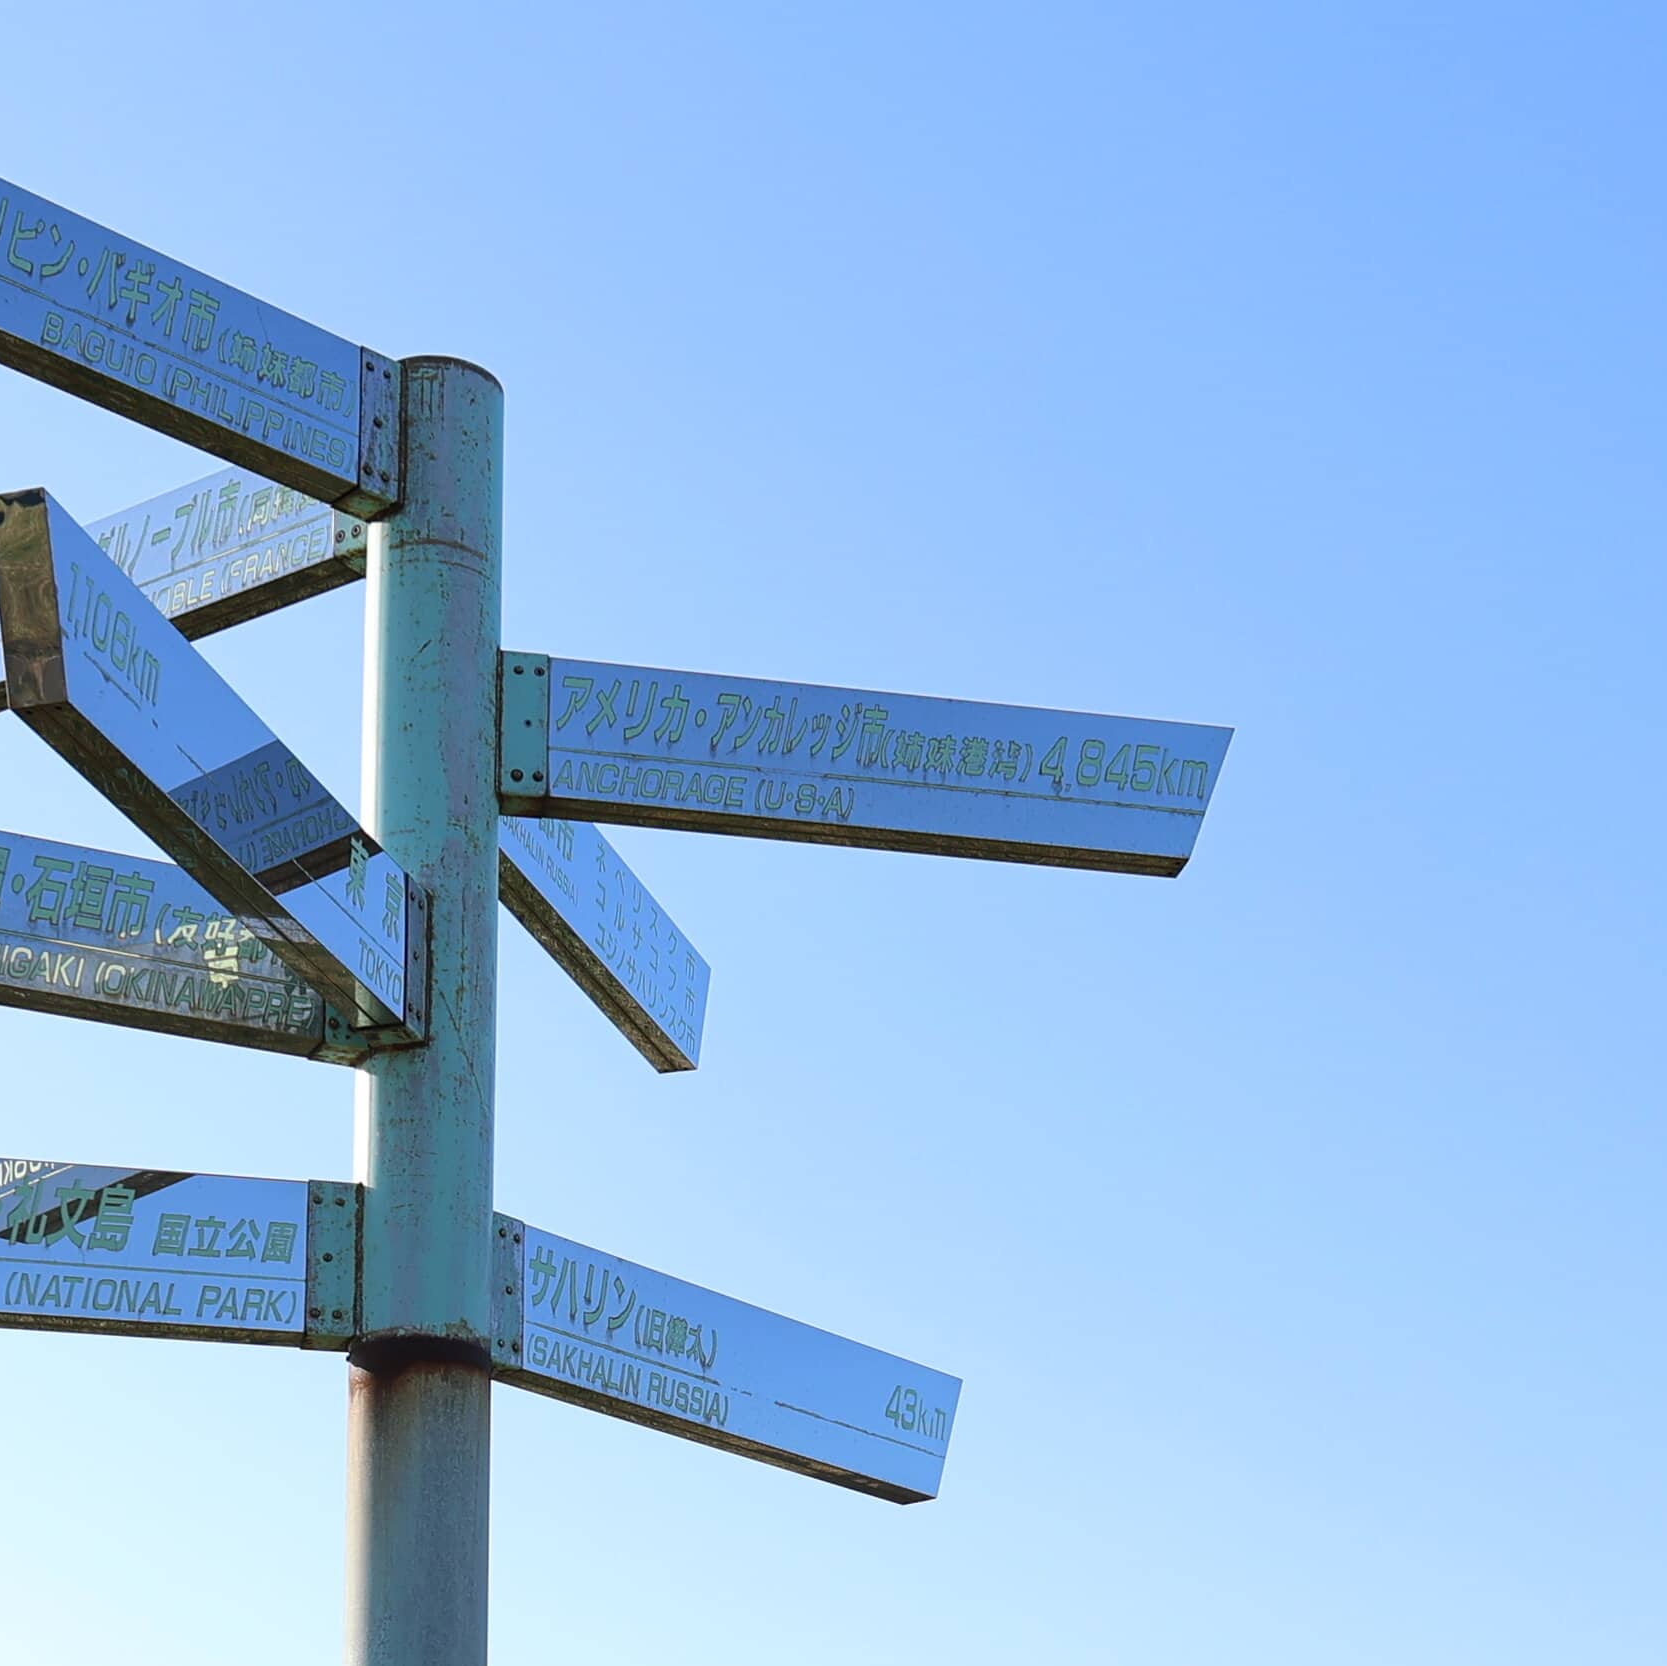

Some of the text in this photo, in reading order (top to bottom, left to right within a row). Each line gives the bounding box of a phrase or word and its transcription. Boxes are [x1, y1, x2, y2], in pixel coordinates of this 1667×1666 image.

[41, 312, 355, 474] BAGUIO (PHILIPPINES)
[552, 759, 747, 808] ANCHORAGE
[1038, 735, 1209, 799] 4,845km
[346, 836, 404, 943] 東京
[358, 938, 404, 1003] TOKYO
[152, 1212, 299, 1265] 国立公園
[5, 1272, 182, 1318] (NATIONAL
[196, 1282, 299, 1326] PARK)
[526, 1332, 730, 1427] (SAKHALIN RUSSIA)
[884, 1384, 948, 1442] 43km
